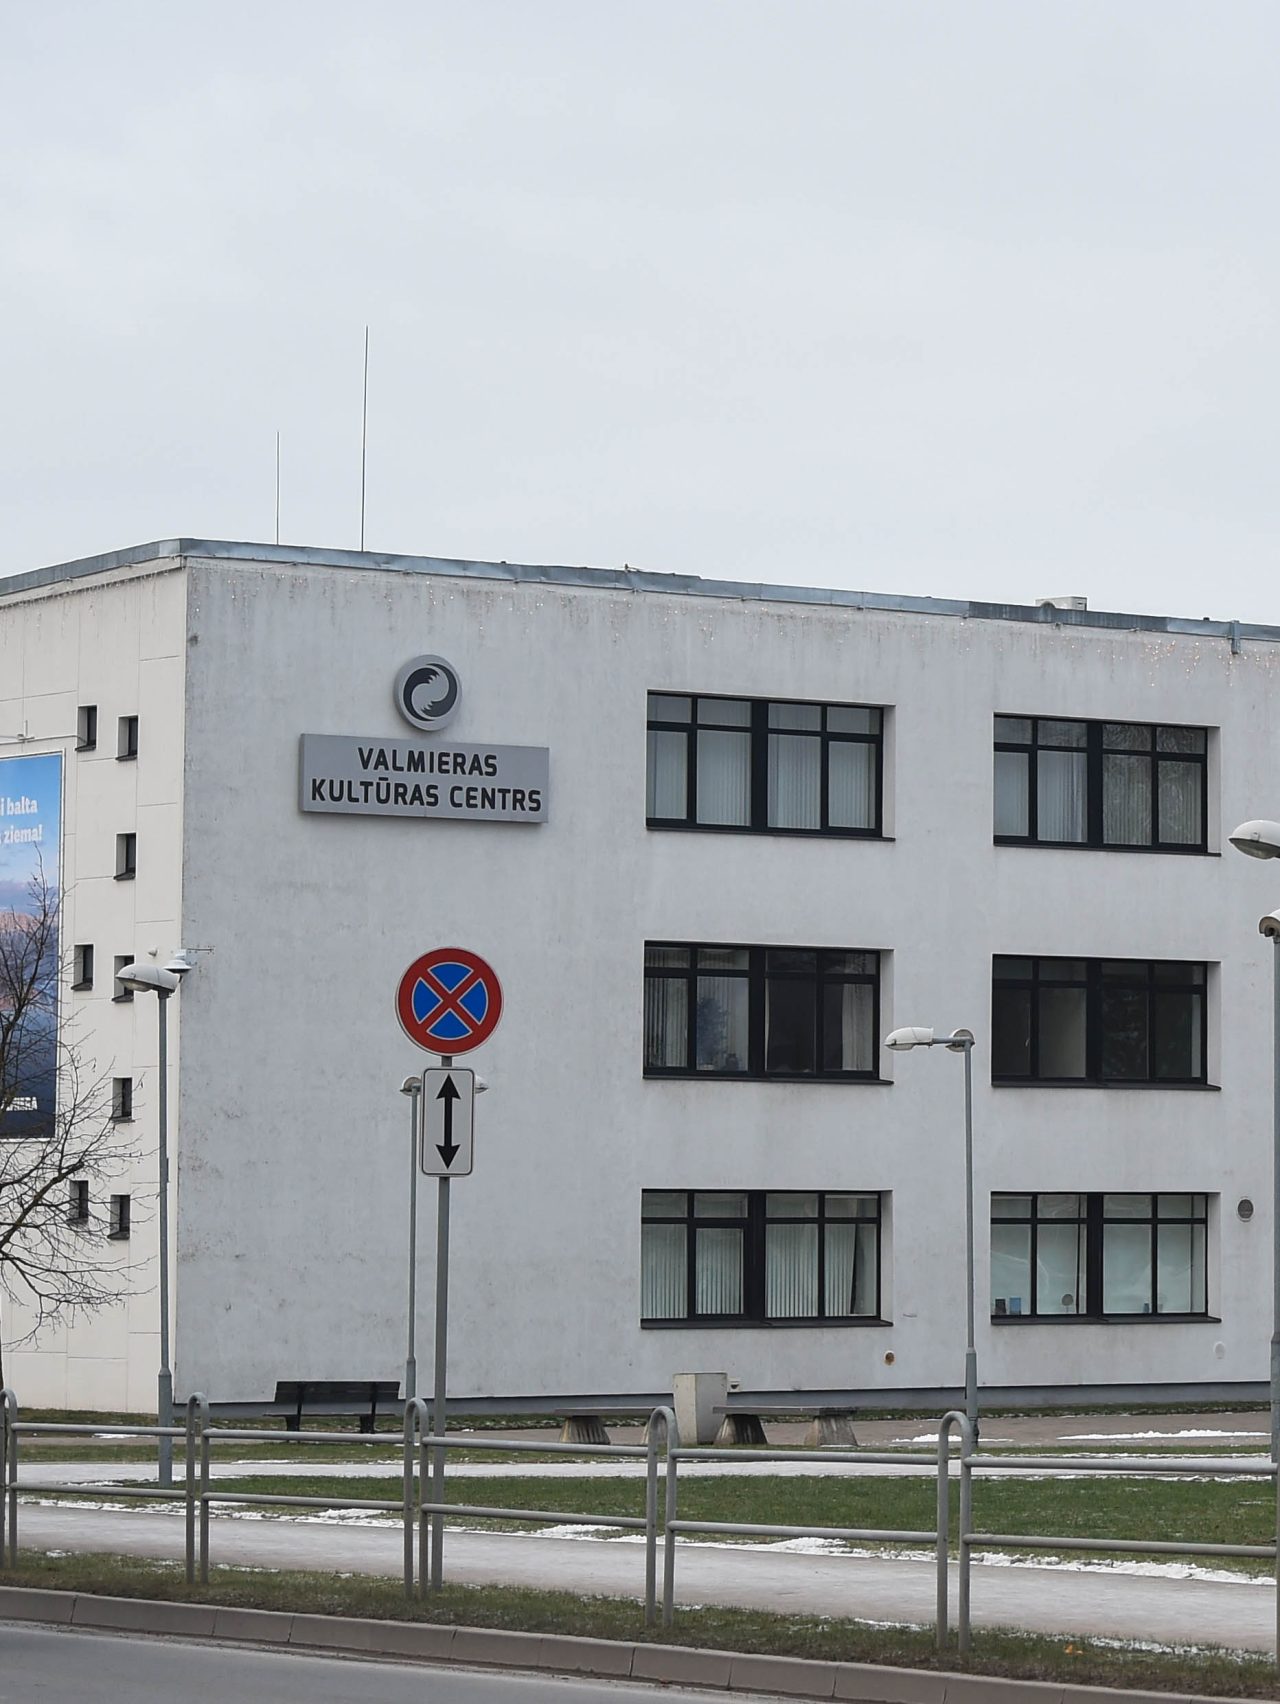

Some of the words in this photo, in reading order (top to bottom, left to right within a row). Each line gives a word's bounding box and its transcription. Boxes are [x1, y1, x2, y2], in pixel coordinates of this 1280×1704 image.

[357, 746, 498, 777] VALMIERAS
[6, 795, 38, 816] balta
[311, 777, 439, 807] KULTŪRAS
[449, 785, 542, 812] CENTRS
[4, 824, 43, 844] ziema!
